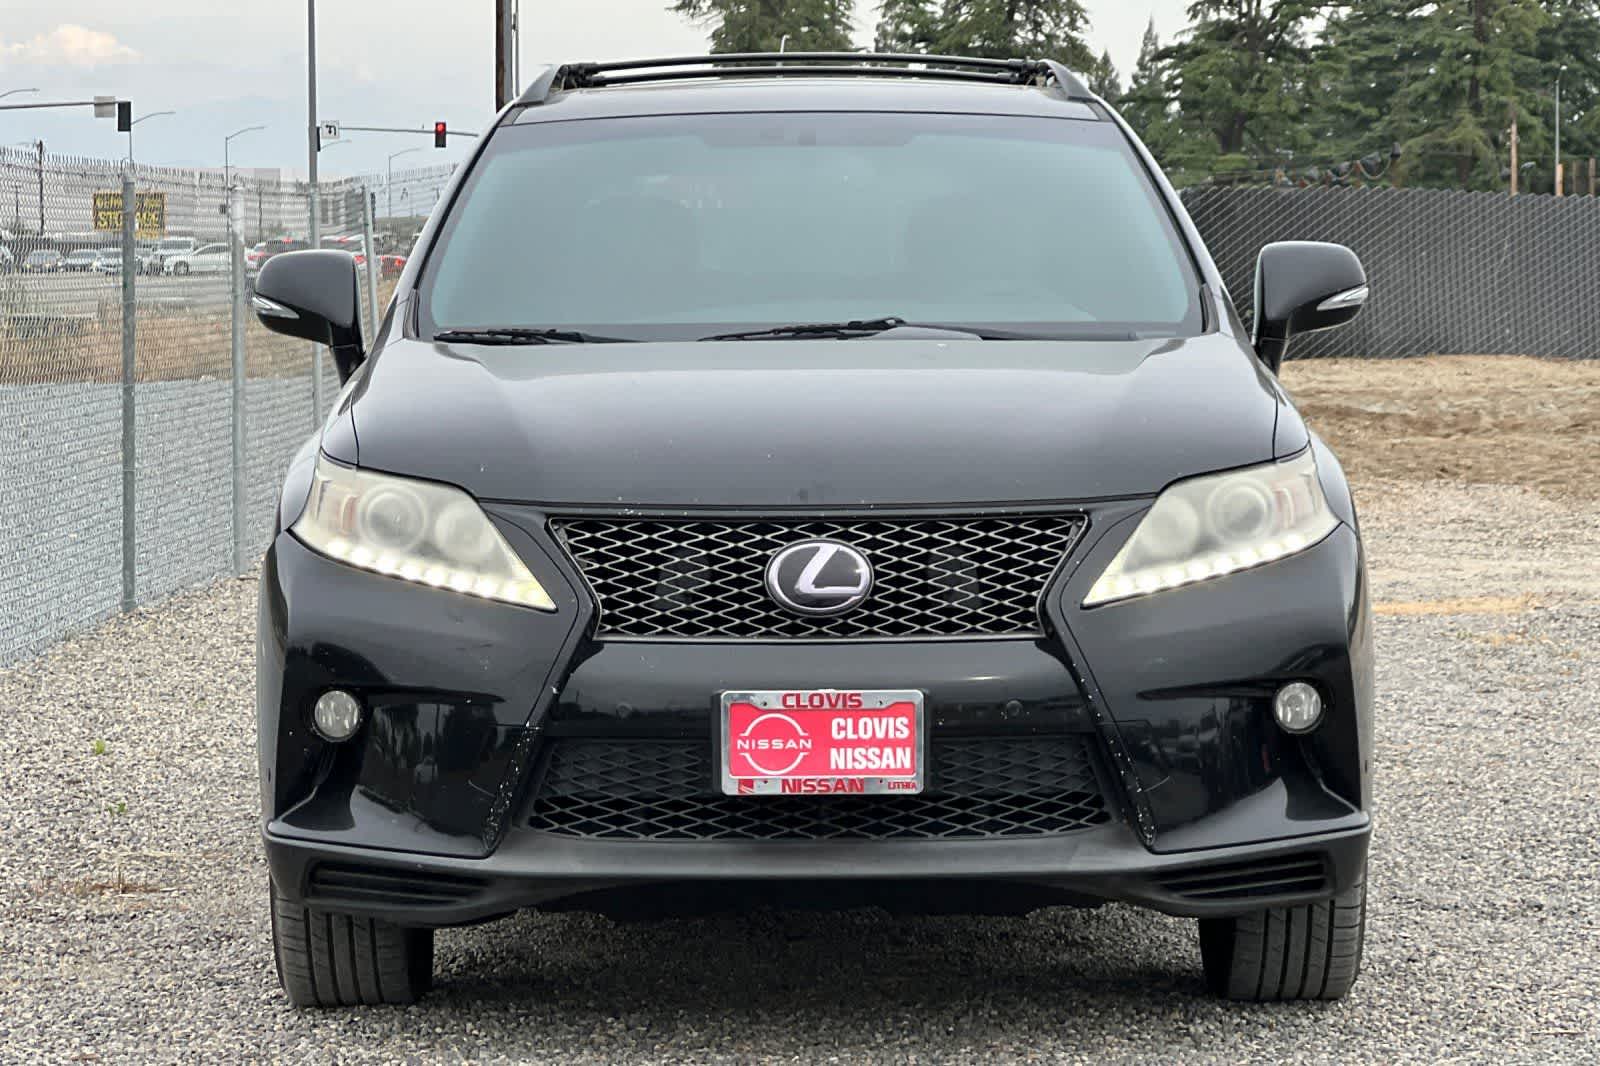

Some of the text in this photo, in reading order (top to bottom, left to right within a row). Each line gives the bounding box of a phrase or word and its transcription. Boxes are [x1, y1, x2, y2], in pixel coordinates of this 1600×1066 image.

[782, 693, 862, 708] CLOVIS
[831, 717, 909, 740] CLOVIS
[737, 739, 812, 750] NISSAN
[830, 747, 911, 770] NISSAN
[781, 778, 865, 793] NISSAN
